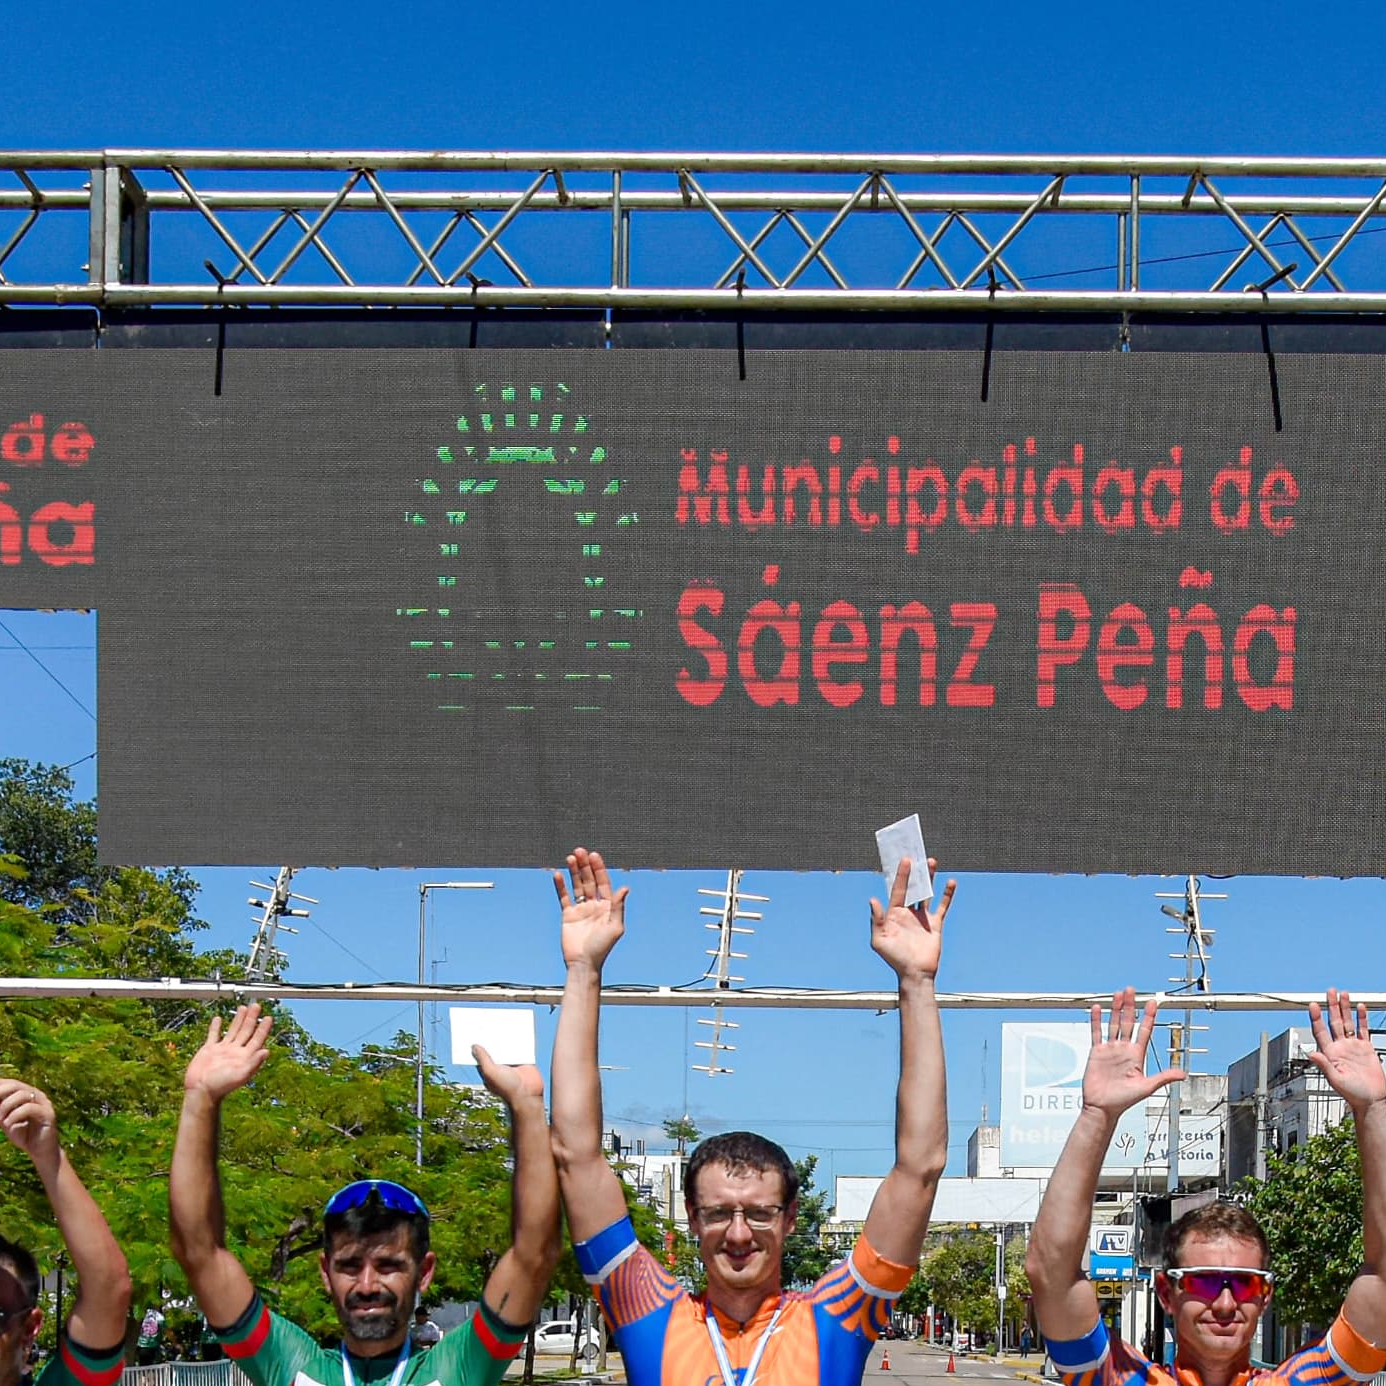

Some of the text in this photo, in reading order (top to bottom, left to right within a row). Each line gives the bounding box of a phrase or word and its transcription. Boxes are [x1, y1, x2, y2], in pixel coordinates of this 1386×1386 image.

[1, 413, 95, 466] de
[675, 435, 1299, 553] Municipalidad de
[675, 565, 1297, 711] Sáenz Peña
[1024, 1094, 1083, 1110] DIRE
